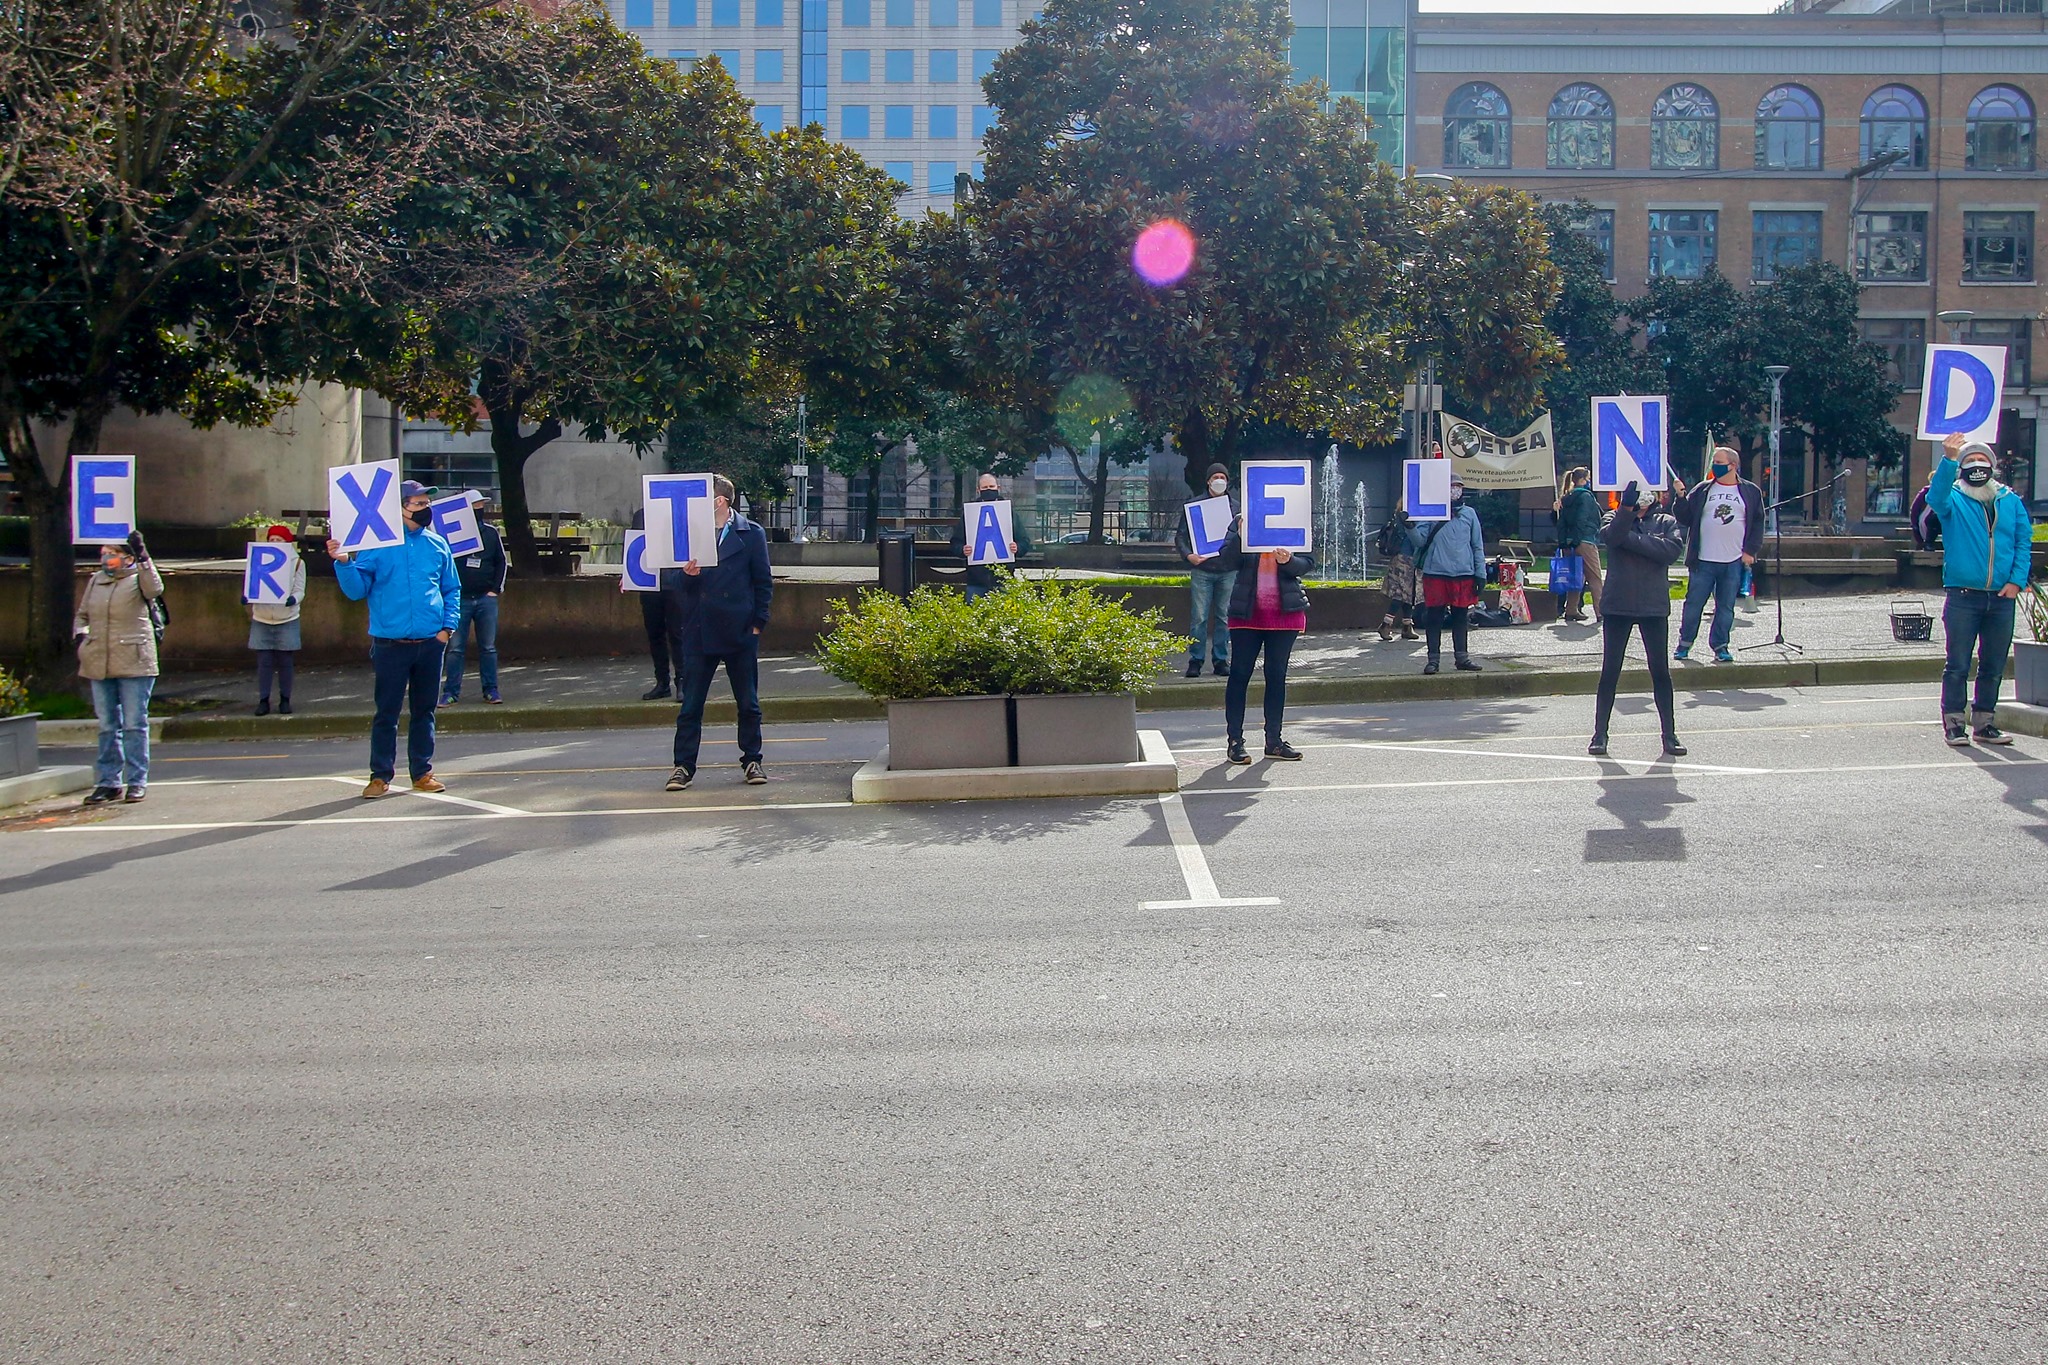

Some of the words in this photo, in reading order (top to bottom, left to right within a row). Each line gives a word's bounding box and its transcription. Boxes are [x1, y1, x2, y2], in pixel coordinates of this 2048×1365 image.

[1926, 350, 1995, 435] D
[1480, 430, 1547, 456] ETEA
[1598, 402, 1660, 485] N
[1407, 463, 1447, 517] L
[1465, 467, 1527, 476] www.eteaunion.org
[1709, 493, 1741, 505] ETEA
[78, 461, 130, 539] E
[336, 467, 397, 547] X
[430, 497, 480, 554] E
[649, 479, 707, 562] T
[1247, 466, 1306, 547] E
[973, 505, 1009, 561] A
[1189, 505, 1226, 556] L
[248, 546, 288, 600] R
